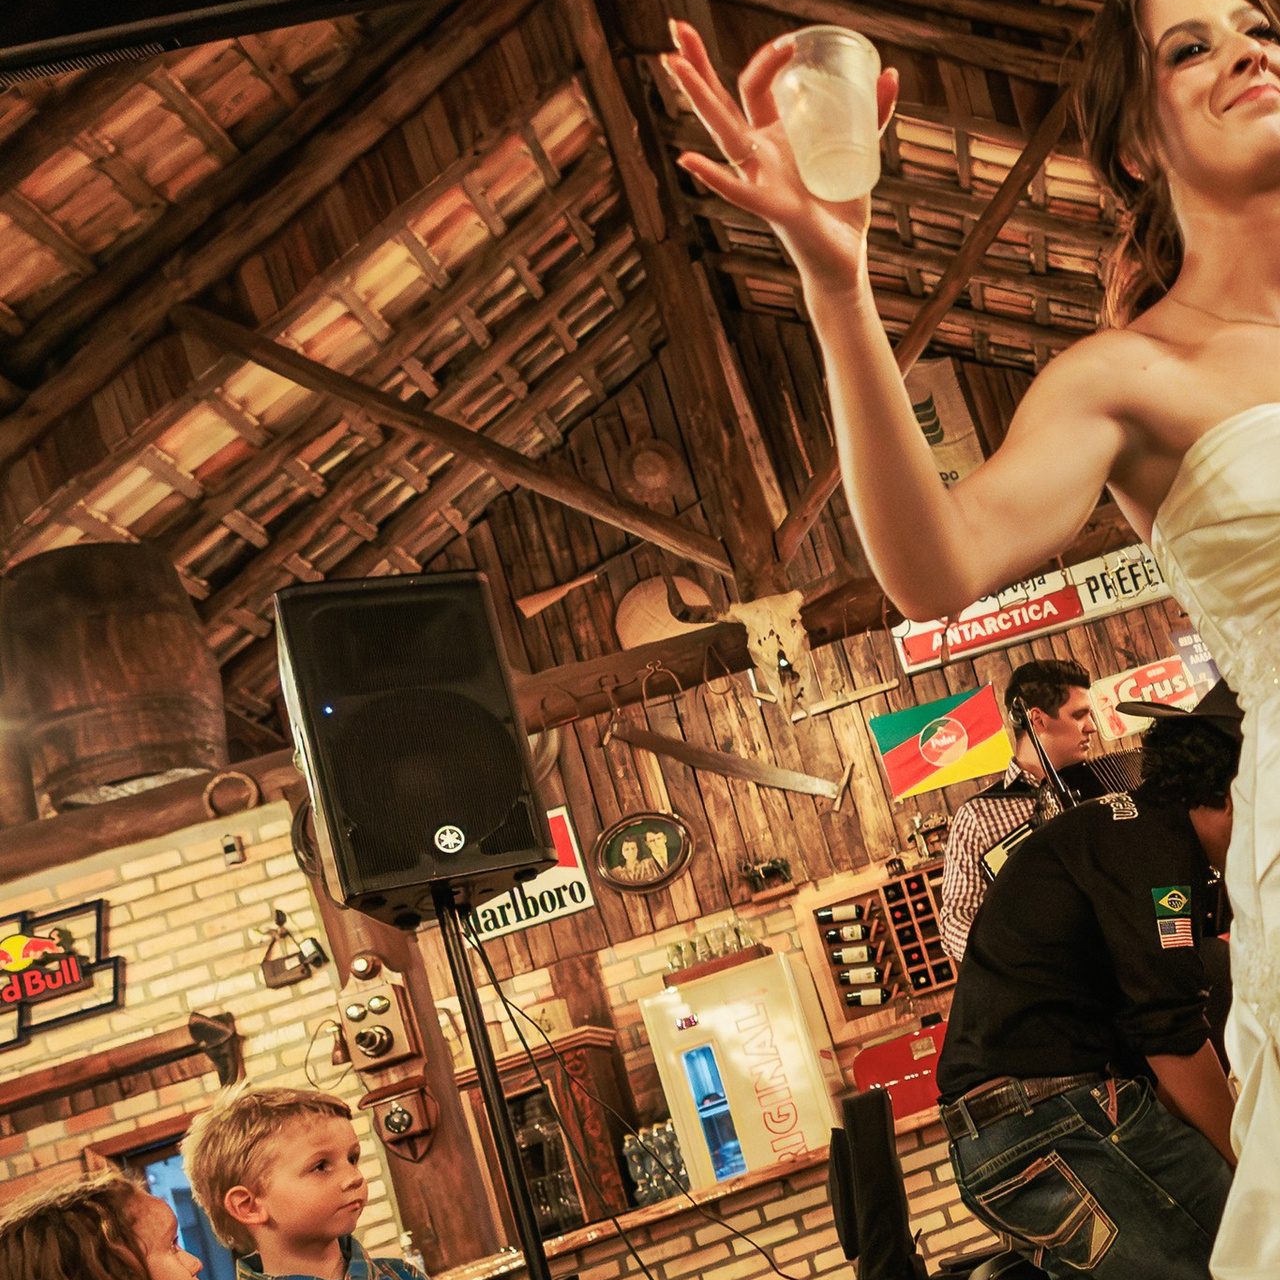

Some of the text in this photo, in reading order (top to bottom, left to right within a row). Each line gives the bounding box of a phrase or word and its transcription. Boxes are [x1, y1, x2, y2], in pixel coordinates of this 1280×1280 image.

[1085, 555, 1165, 604] PREFE
[932, 600, 1059, 651] ANTARCTICA
[23, 956, 81, 997] Bull
